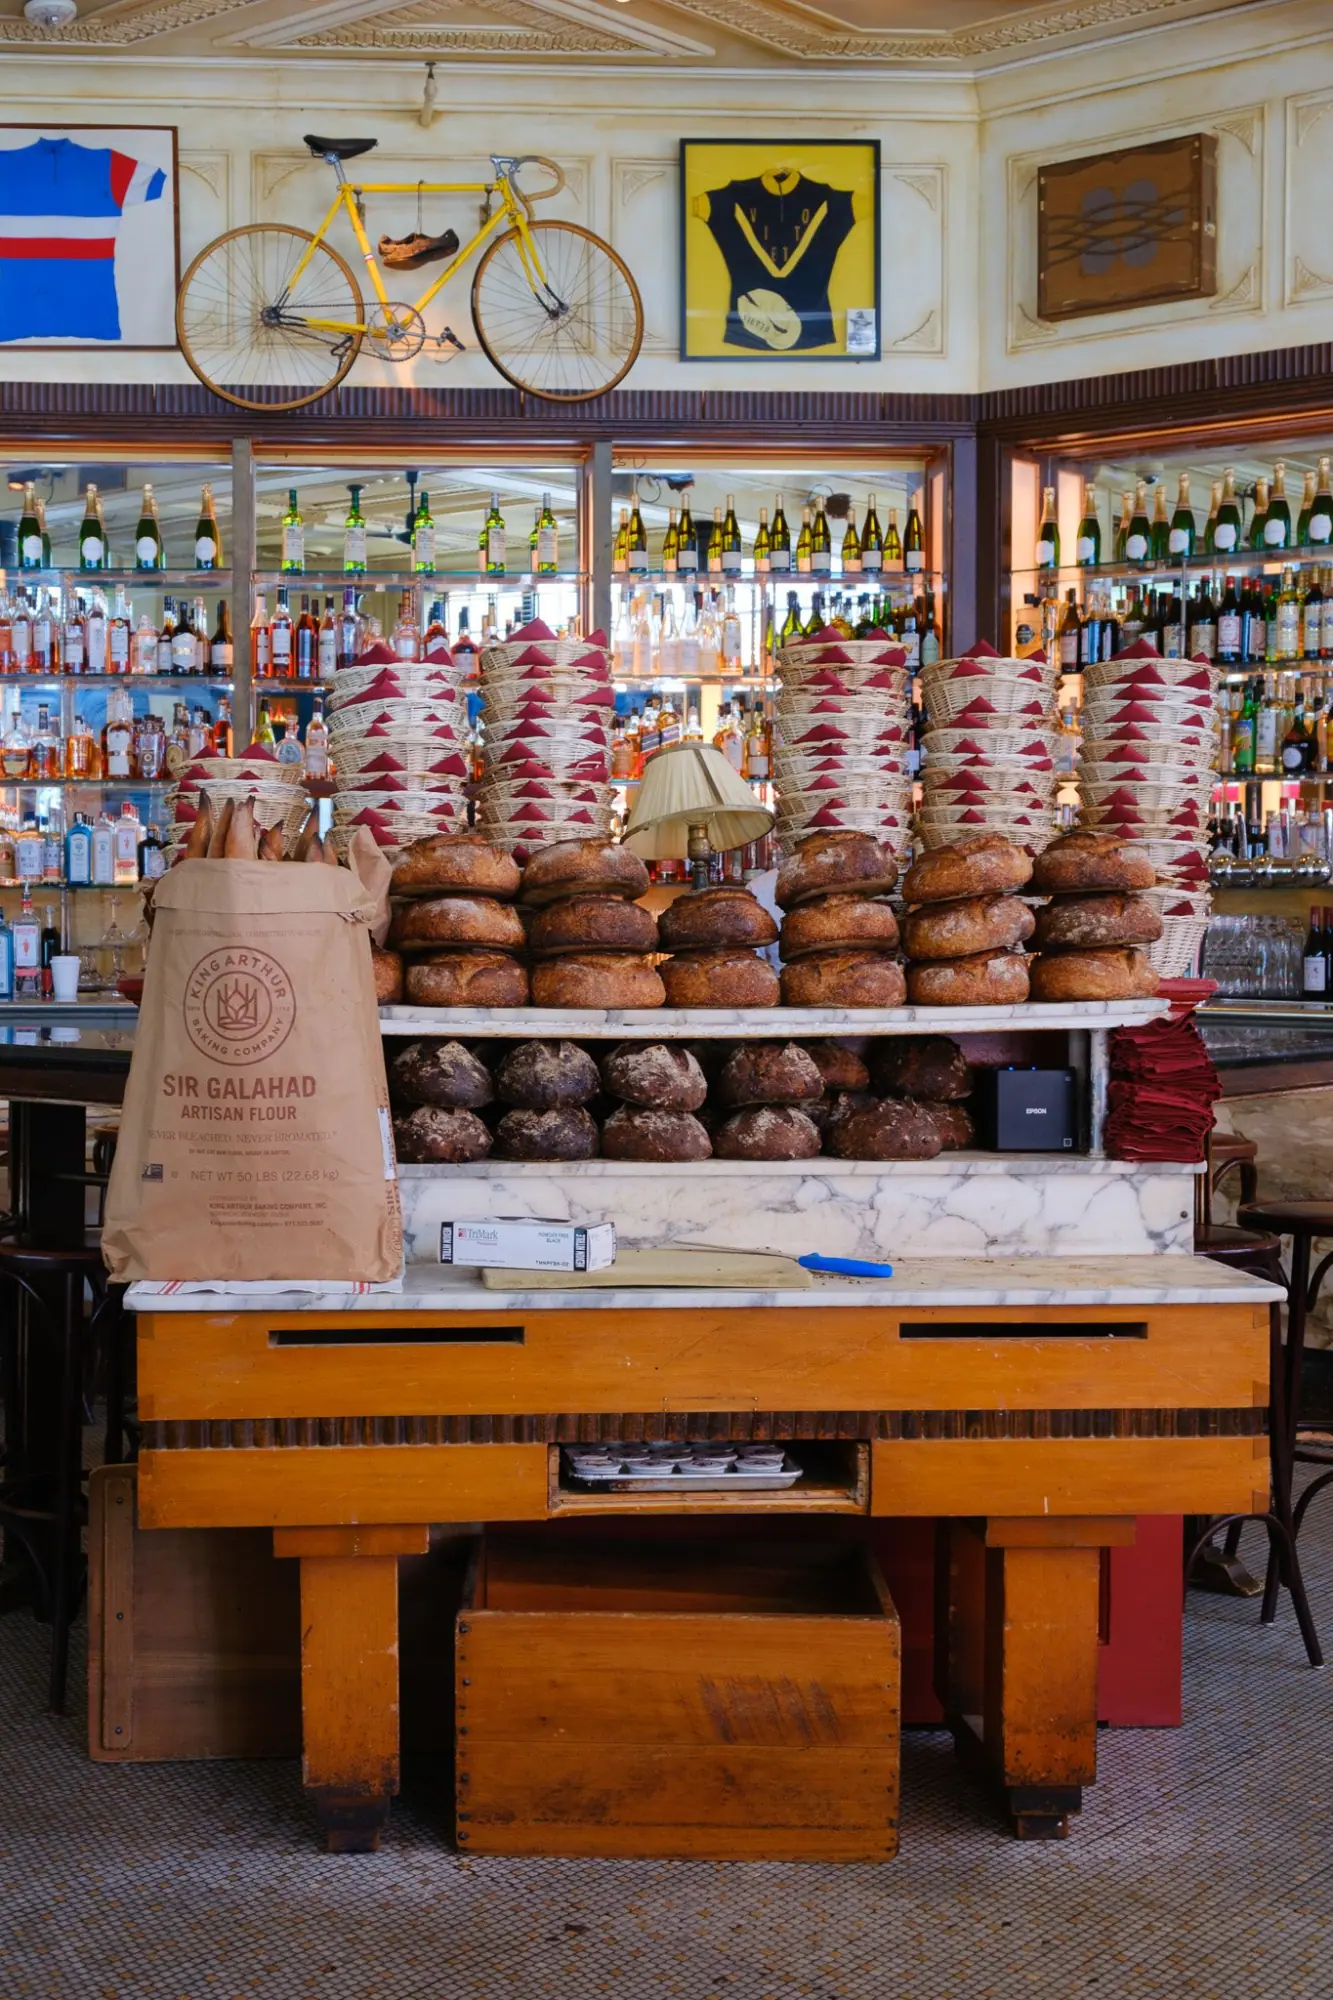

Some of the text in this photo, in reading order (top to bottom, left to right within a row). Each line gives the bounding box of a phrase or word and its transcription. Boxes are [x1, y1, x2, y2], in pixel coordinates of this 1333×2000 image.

[190, 954, 287, 1000] KING ARTHUR
[192, 1018, 284, 1057] BAKING COMPANY
[162, 1074, 317, 1100] SIR GALAHAD
[181, 1105, 298, 1122] ARTISAN FLOUR
[236, 1133, 273, 1144] NEVER
[190, 1168, 340, 1183] NET WT 50 LBS (22.68 kg)
[467, 1228, 499, 1240] TriMark
